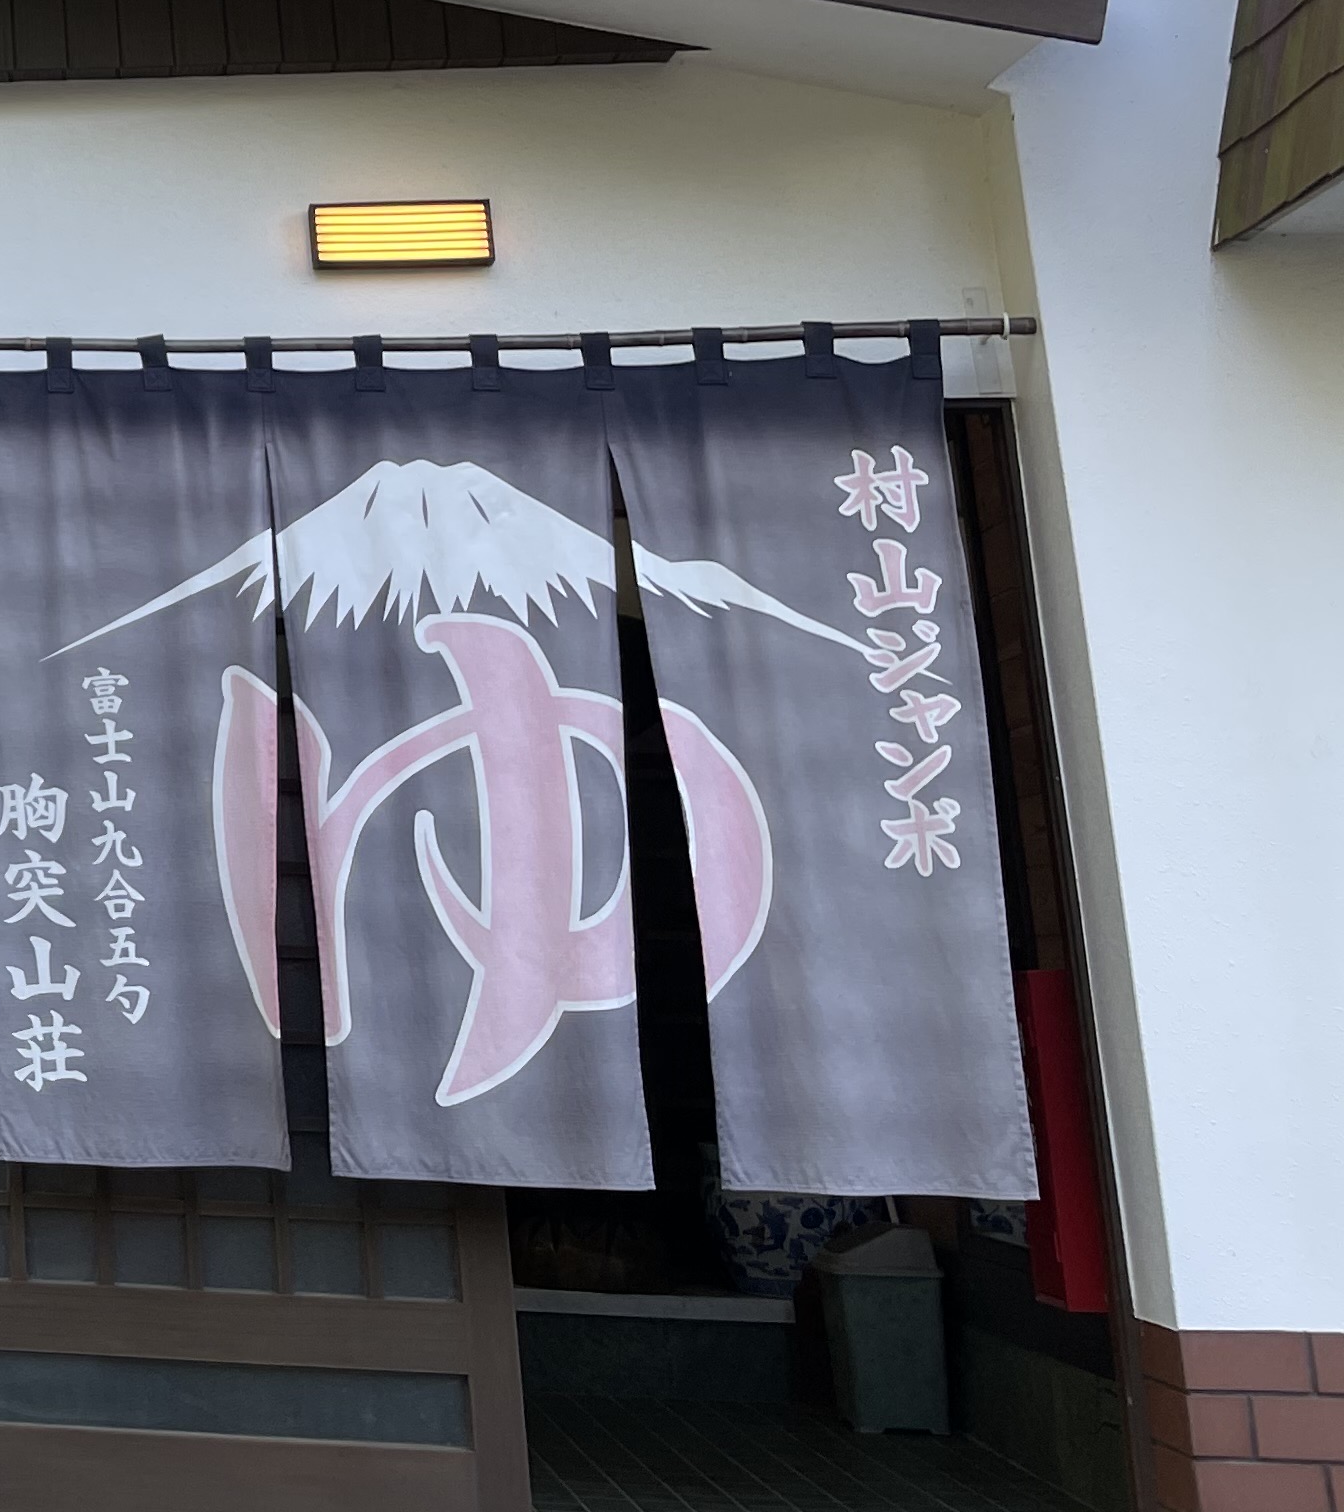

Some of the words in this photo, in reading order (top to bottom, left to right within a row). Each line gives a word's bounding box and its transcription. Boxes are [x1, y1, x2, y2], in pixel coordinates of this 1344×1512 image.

[82, 667, 151, 1025] 富士山九合五勺
[212, 612, 773, 1107] ゆ
[834, 445, 962, 877] 村山ジャンボ
